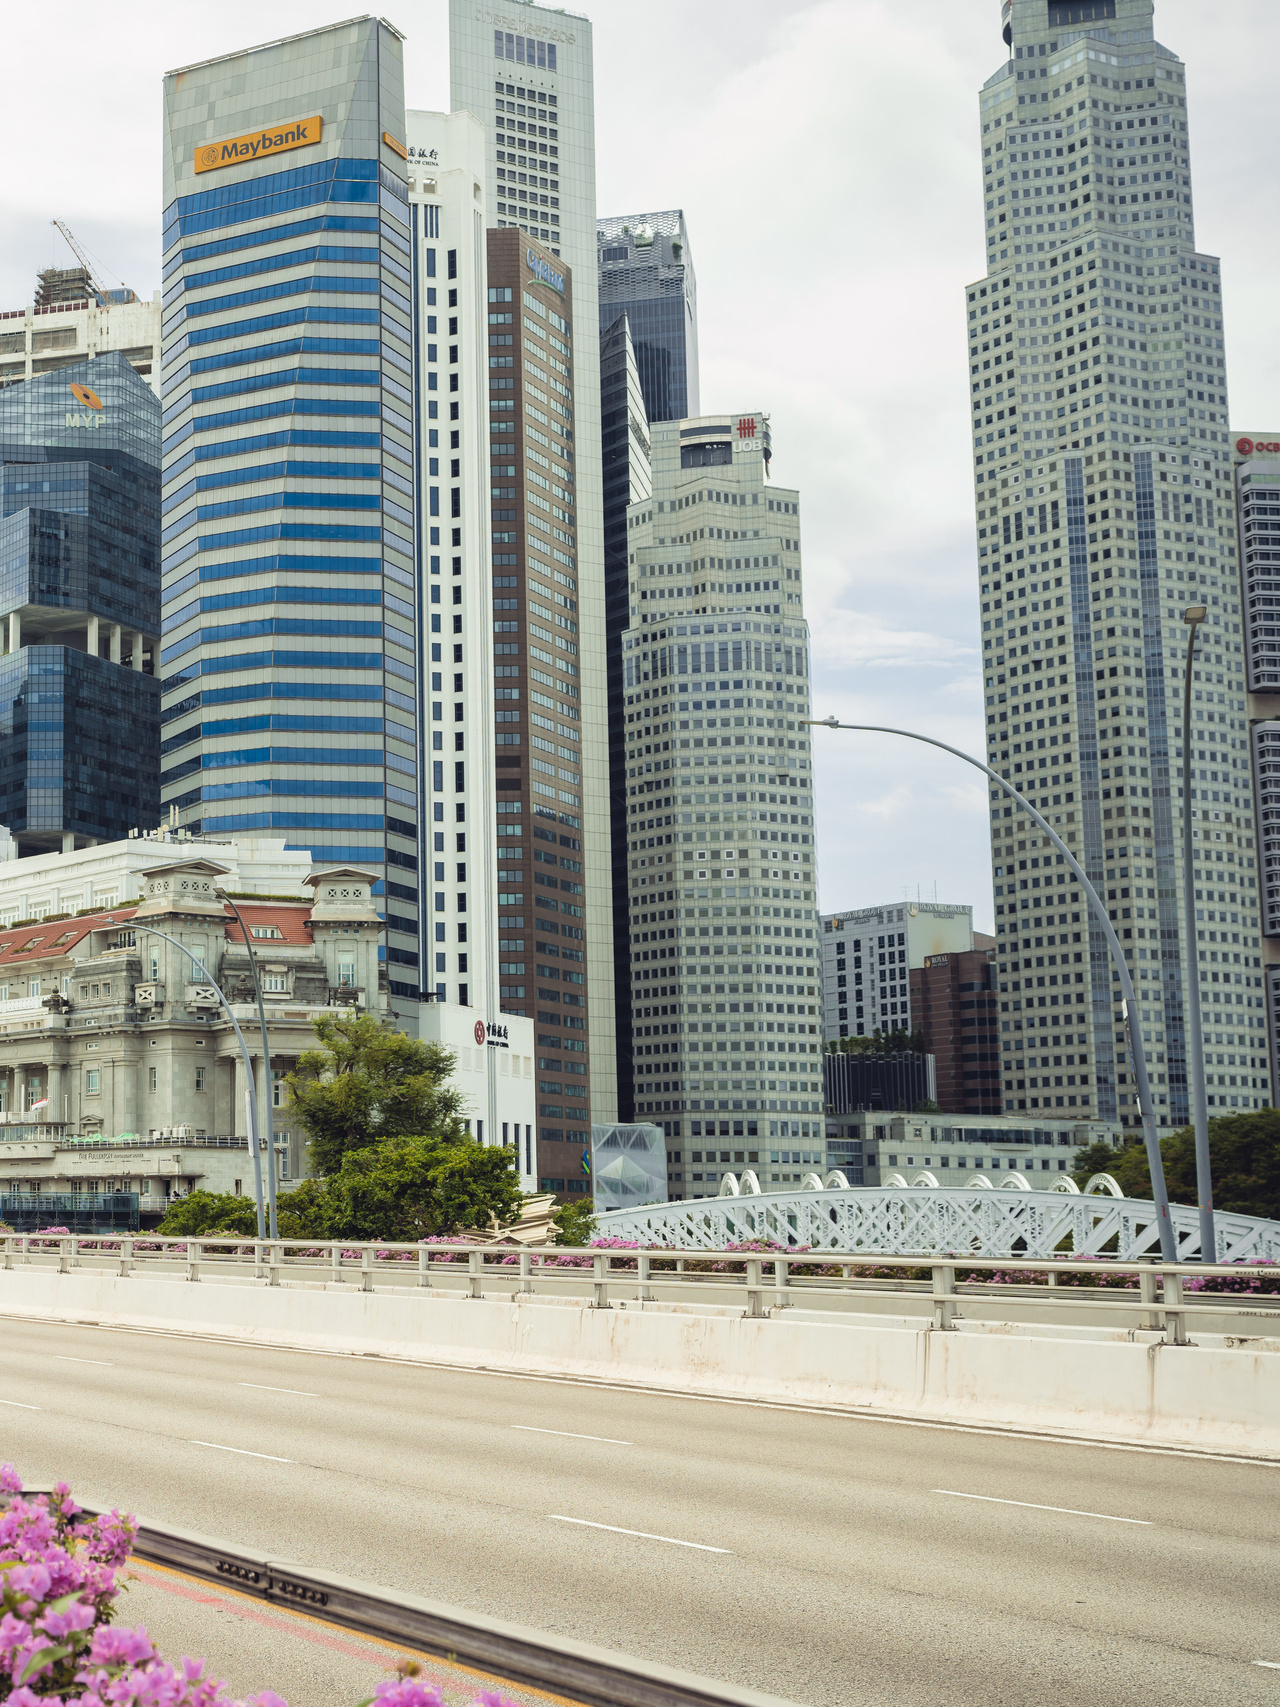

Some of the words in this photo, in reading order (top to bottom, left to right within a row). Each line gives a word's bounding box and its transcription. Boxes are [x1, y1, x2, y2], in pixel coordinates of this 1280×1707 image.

[221, 124, 308, 160] Maybank
[65, 413, 107, 429] MYP
[733, 440, 762, 453] UOB
